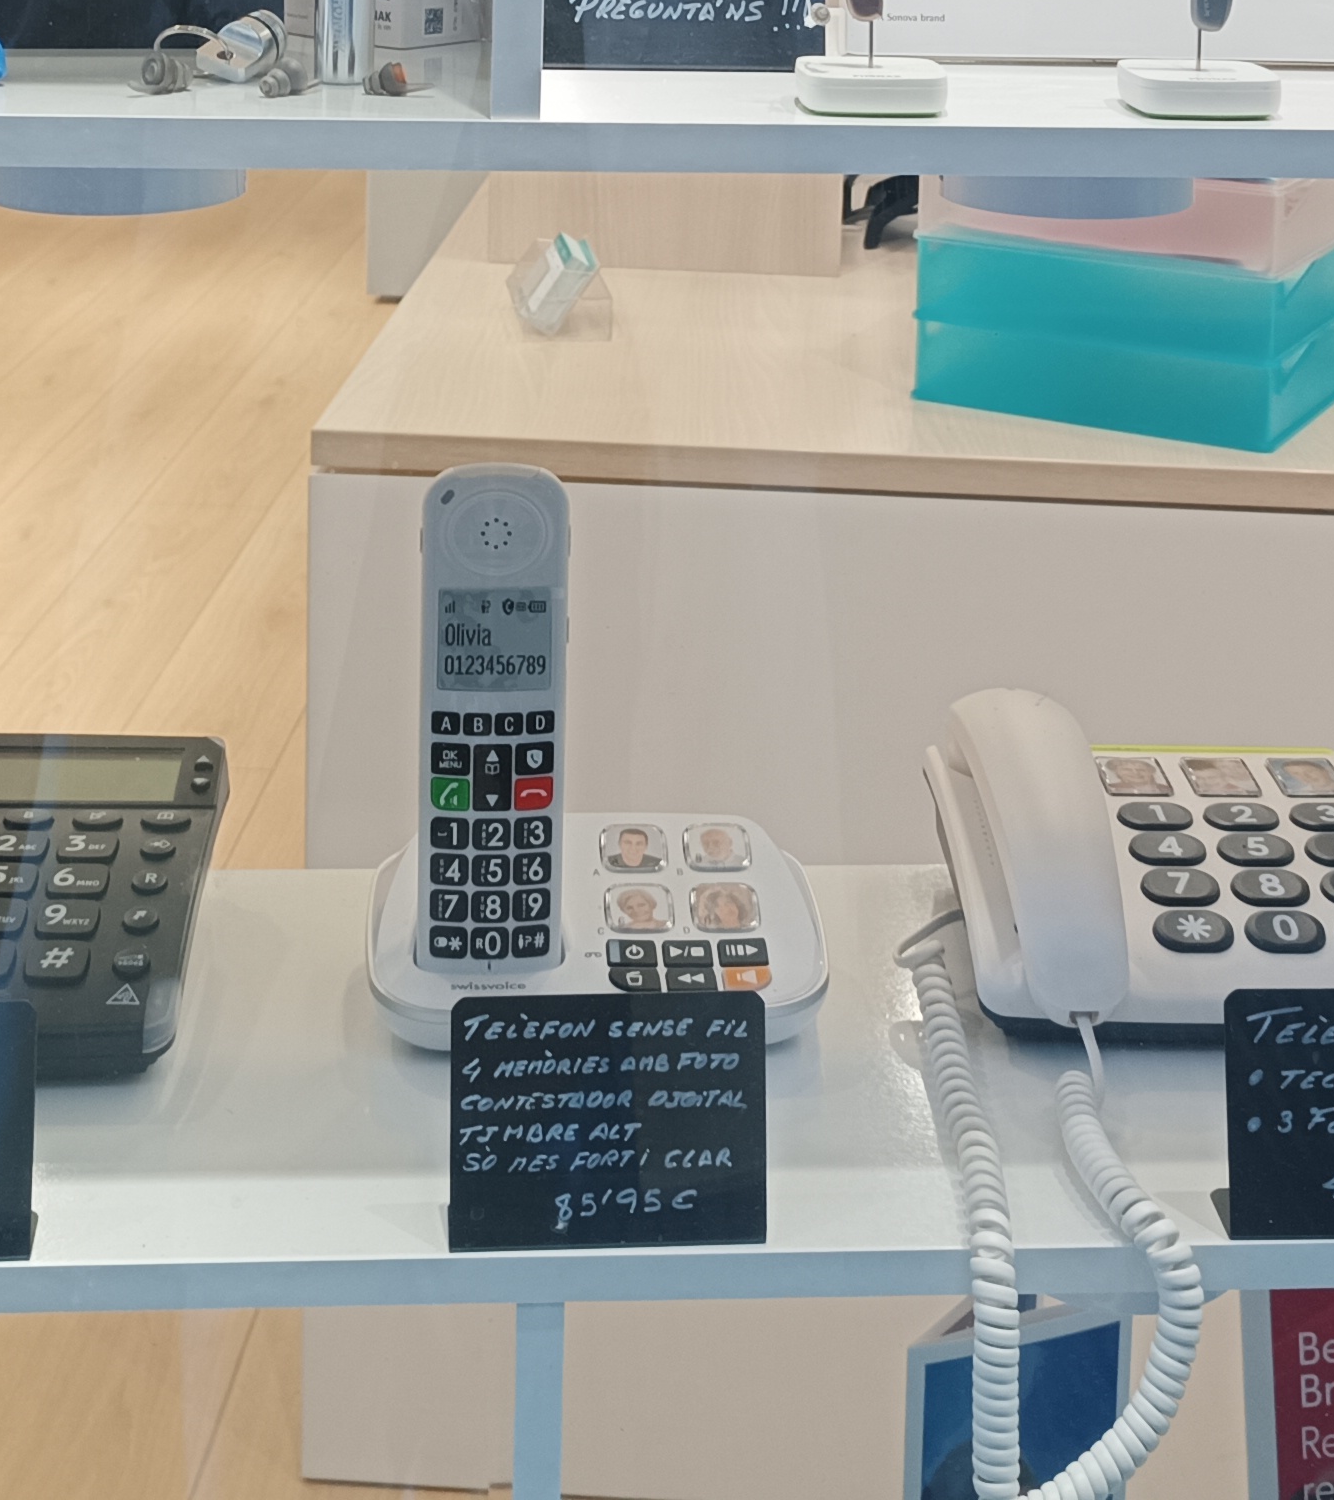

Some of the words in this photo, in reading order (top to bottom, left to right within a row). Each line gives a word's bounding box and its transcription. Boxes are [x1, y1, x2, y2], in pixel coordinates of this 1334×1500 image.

[886, 12, 918, 22] Sonova
[920, 12, 945, 22] brand
[445, 623, 492, 647] Olivia
[444, 655, 547, 676] 0123456789
[441, 716, 451, 731] A
[473, 717, 484, 732] B
[504, 716, 514, 732] C
[535, 715, 545, 730] D
[439, 761, 462, 769] MENU
[442, 750, 458, 760] OK
[1148, 804, 1167, 822] 1
[1229, 804, 1258, 823] 2
[65, 834, 87, 851] 3
[449, 822, 458, 846] 1
[487, 822, 504, 847] 2
[529, 820, 545, 845] 3
[1157, 836, 1183, 857] 4
[1246, 836, 1269, 857] 5
[53, 867, 75, 886] 6
[144, 872, 158, 884] R
[445, 858, 461, 882] 4
[487, 858, 503, 883] 5
[528, 856, 544, 881] 6
[1166, 871, 1190, 895] 7
[1257, 873, 1285, 897] 8
[44, 904, 67, 925] 9
[444, 894, 459, 919] 7
[485, 894, 502, 920] 8
[528, 892, 543, 918] 9
[1271, 914, 1299, 942] 0
[484, 931, 501, 956] 0
[451, 980, 527, 990] swissvoice
[464, 1013, 596, 1042] TELÈFON
[608, 1018, 693, 1038] SENSE
[462, 1057, 481, 1082] 4
[493, 1049, 610, 1079] MEMÒRIES
[620, 1054, 670, 1073] AMB
[677, 1051, 740, 1072] FOTO
[460, 1089, 634, 1112] CONTESTADOR
[1277, 1109, 1293, 1133] 3
[459, 1123, 580, 1145] TIMBRE
[589, 1122, 642, 1142] ALT
[508, 1154, 560, 1173] MES
[569, 1149, 635, 1172] FORT
[664, 1146, 733, 1169] CLAR
